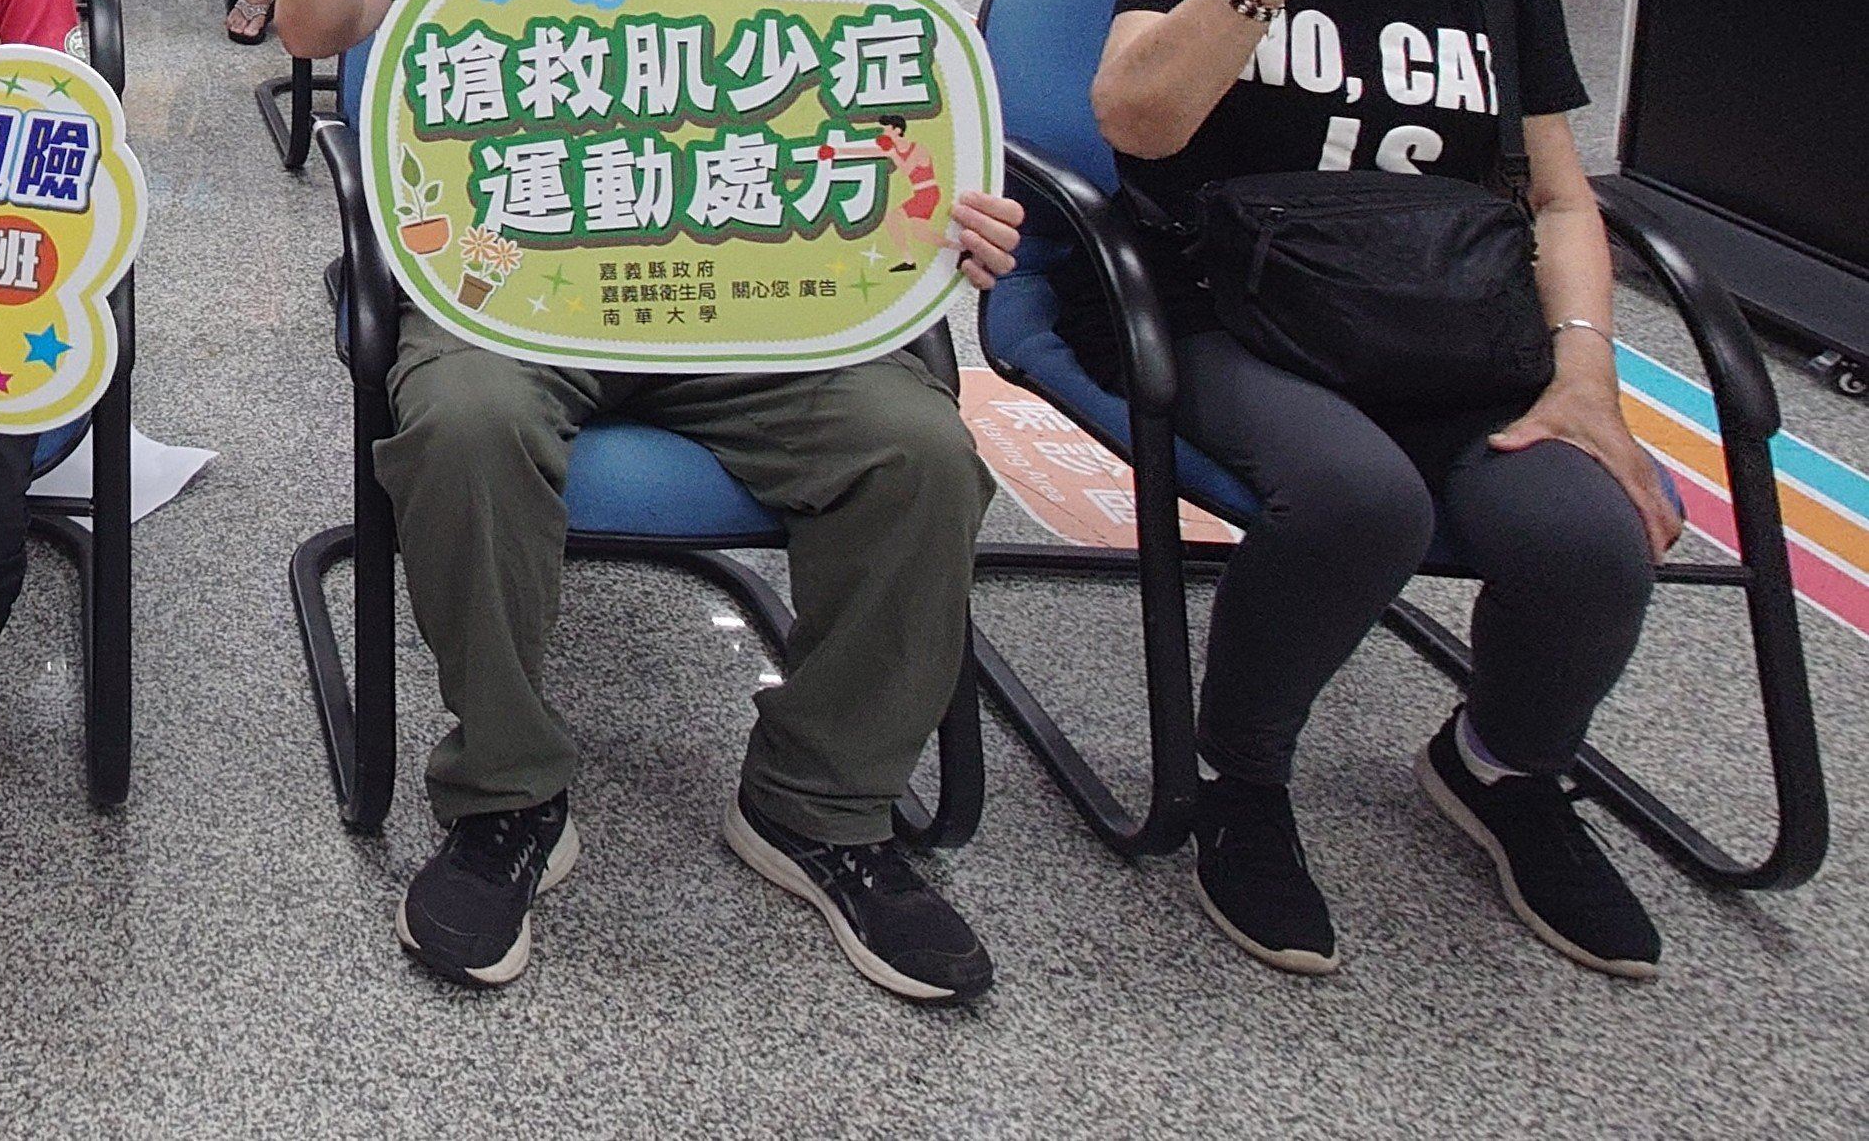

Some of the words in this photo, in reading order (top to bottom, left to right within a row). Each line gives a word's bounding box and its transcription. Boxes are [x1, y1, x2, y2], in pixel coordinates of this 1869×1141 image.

[416, 14, 931, 125] 搶救肌少症
[479, 131, 893, 234] 運動處方
[599, 261, 715, 281] 嘉義縣政府
[601, 282, 717, 304] 嘉義縣衛生局
[732, 280, 791, 301] 關心您
[799, 279, 837, 299] 廣告
[602, 305, 718, 327] 南華大學
[972, 417, 1031, 469] Waiting
[1028, 468, 1067, 505] Area
